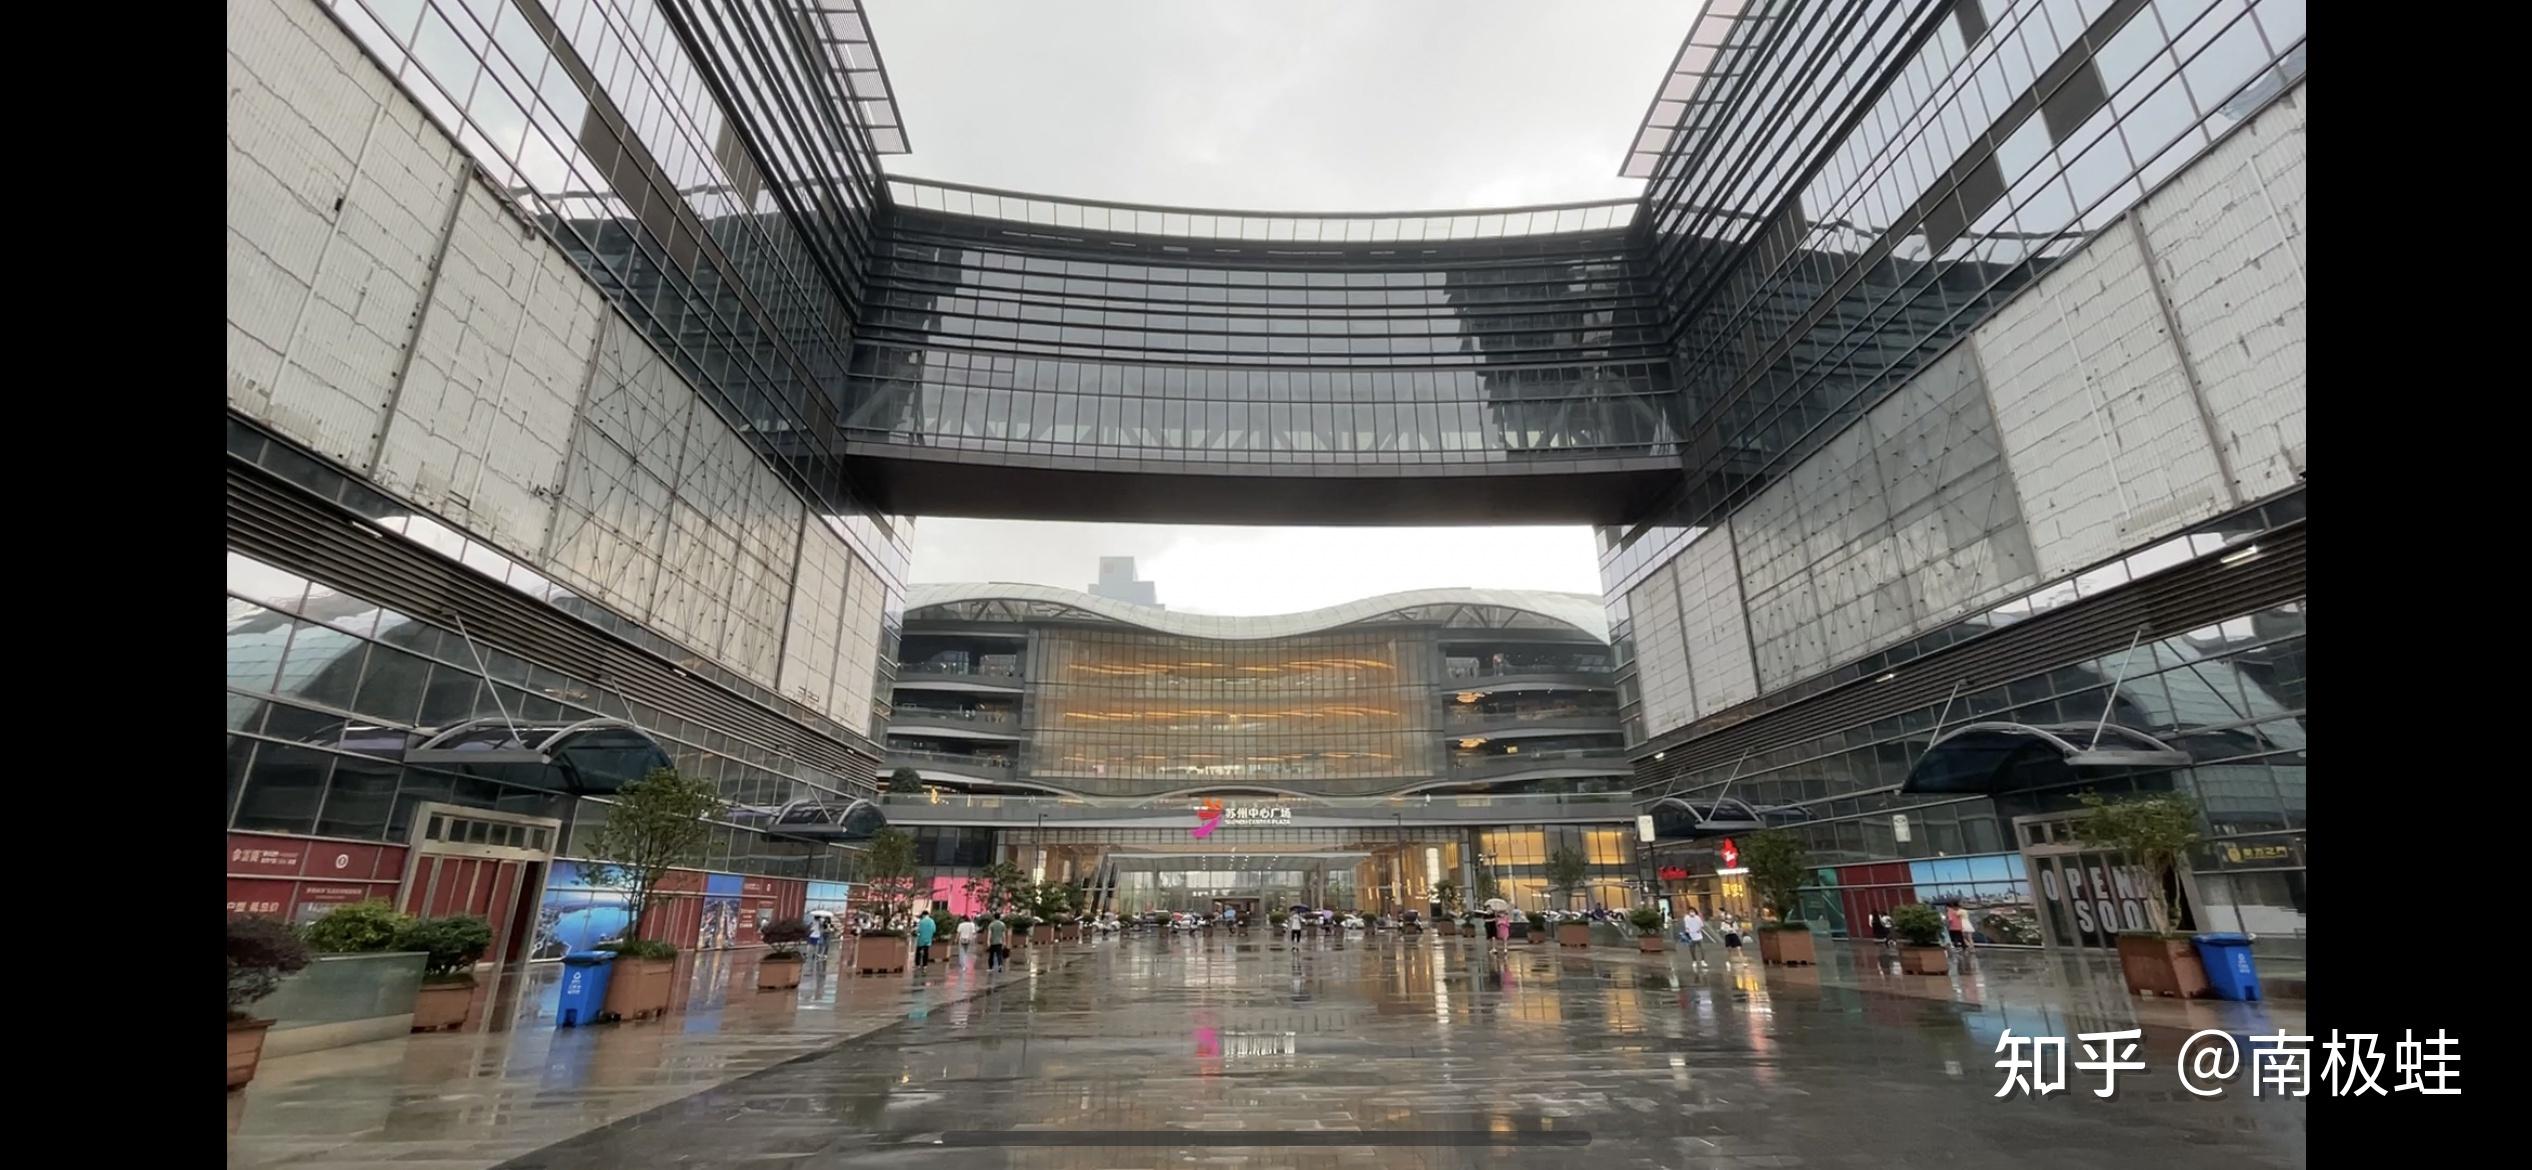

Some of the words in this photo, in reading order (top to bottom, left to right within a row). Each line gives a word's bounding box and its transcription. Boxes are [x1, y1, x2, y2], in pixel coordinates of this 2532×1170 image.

[1224, 807, 1292, 819] 苏州中心广场
